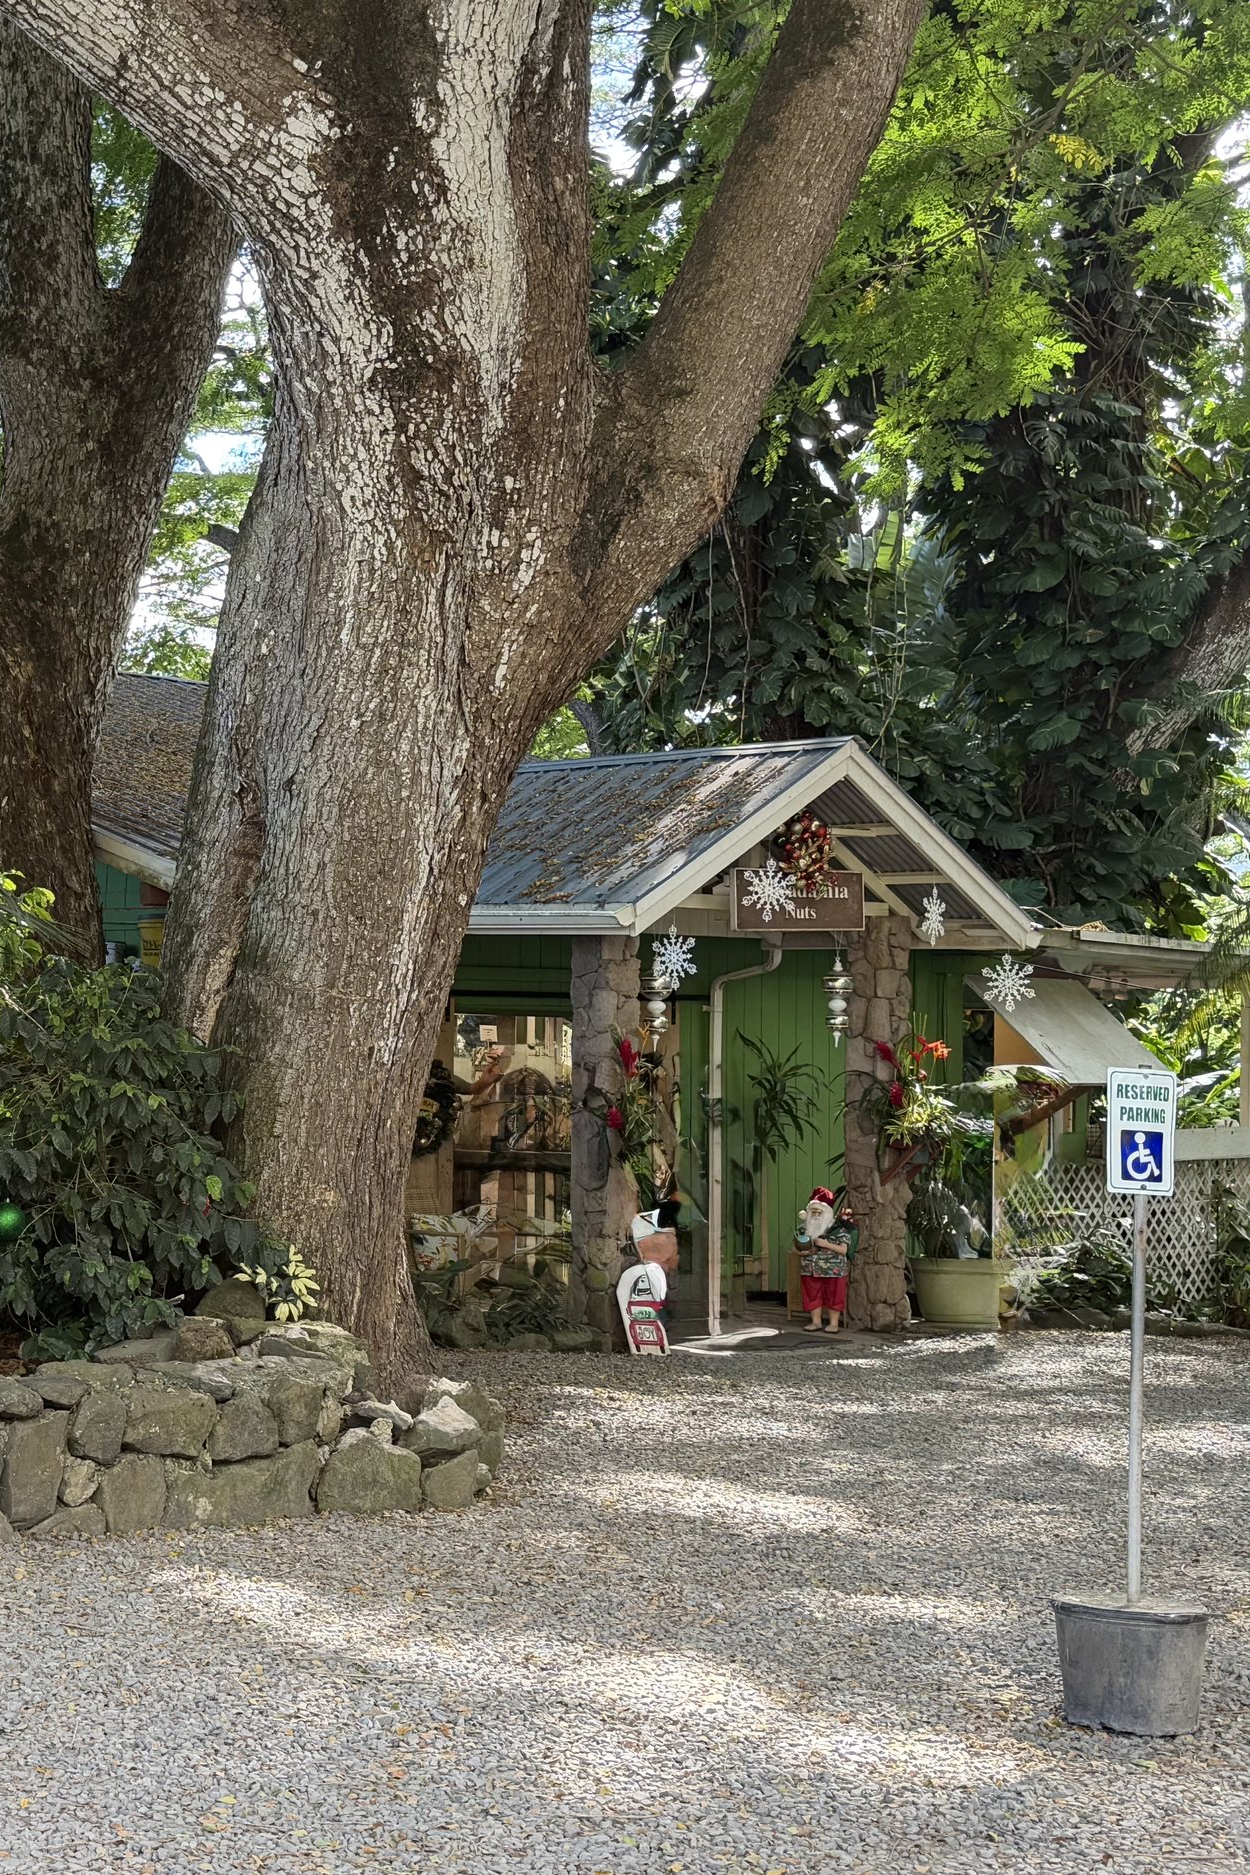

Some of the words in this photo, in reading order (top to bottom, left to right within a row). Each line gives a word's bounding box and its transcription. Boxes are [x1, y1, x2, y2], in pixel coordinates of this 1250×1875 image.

[784, 905, 817, 920] Nuts
[1116, 1083, 1170, 1102] RESERVED
[1119, 1106, 1166, 1124] PARKING
